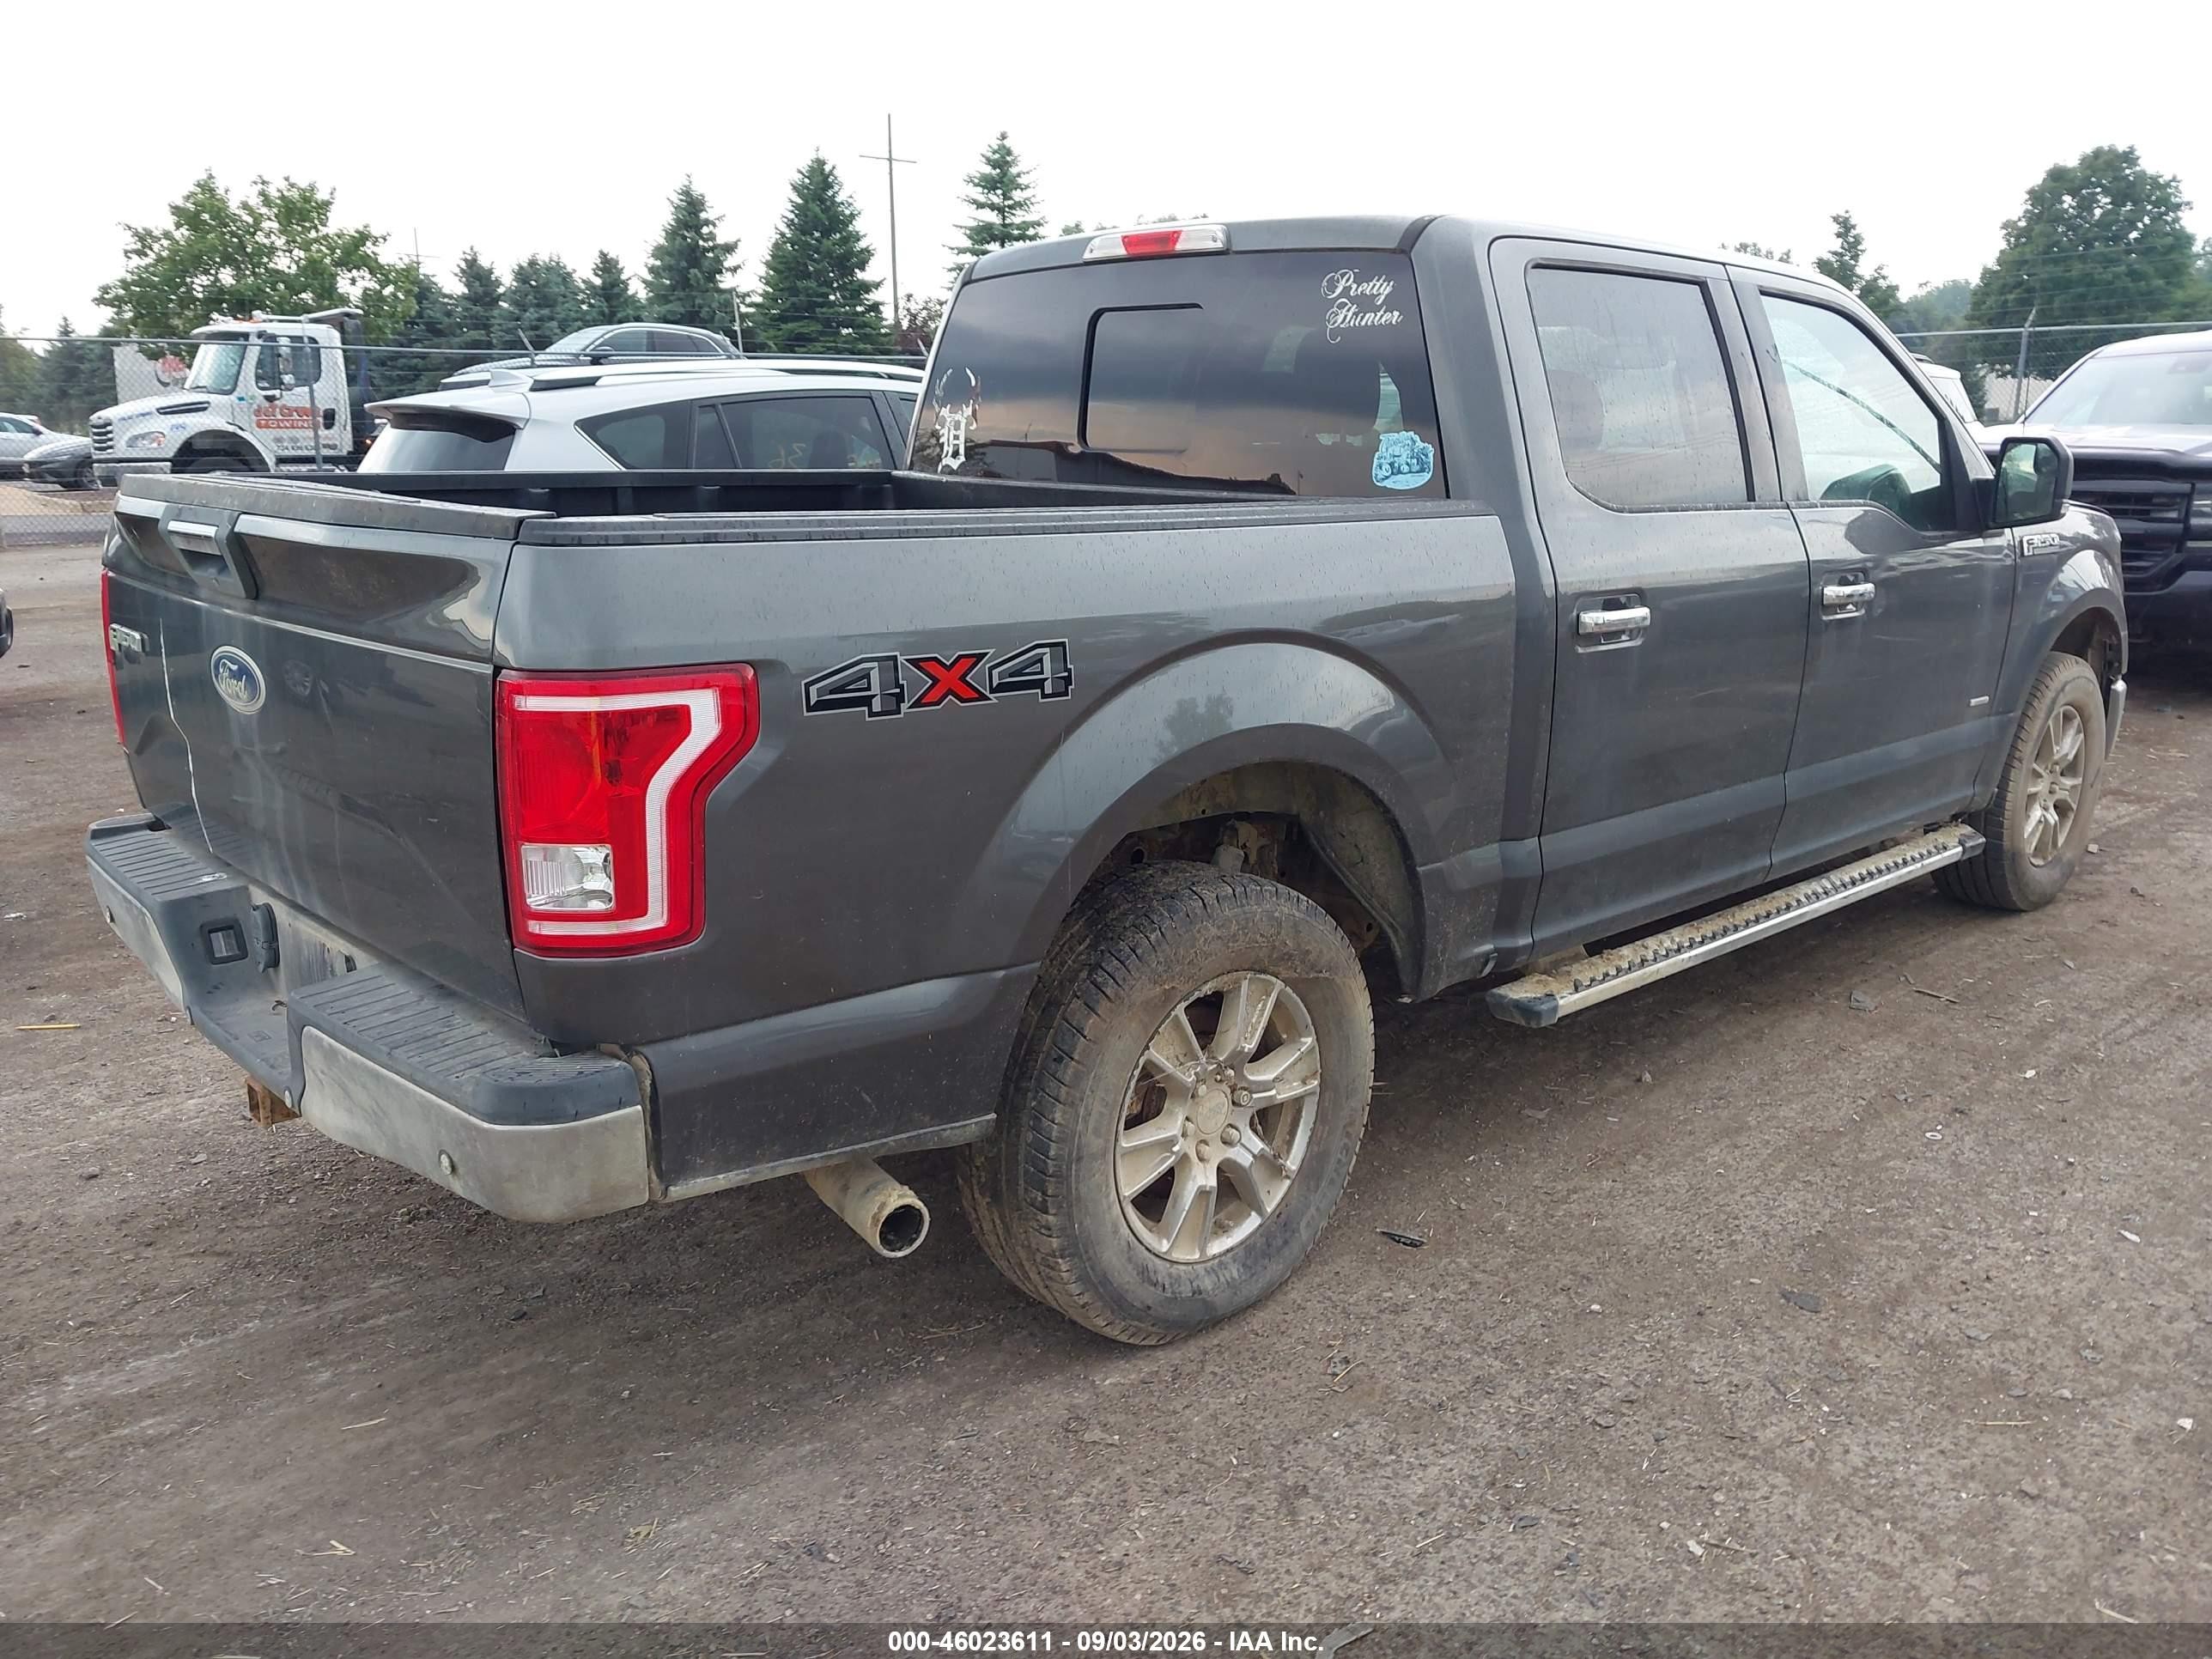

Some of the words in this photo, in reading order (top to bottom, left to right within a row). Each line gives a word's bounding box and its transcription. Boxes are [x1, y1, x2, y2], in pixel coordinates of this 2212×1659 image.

[1322, 269, 1395, 305] Pretty
[1326, 298, 1404, 343] Hunter
[218, 659, 248, 700] Ford
[801, 638, 1073, 721] 4X4
